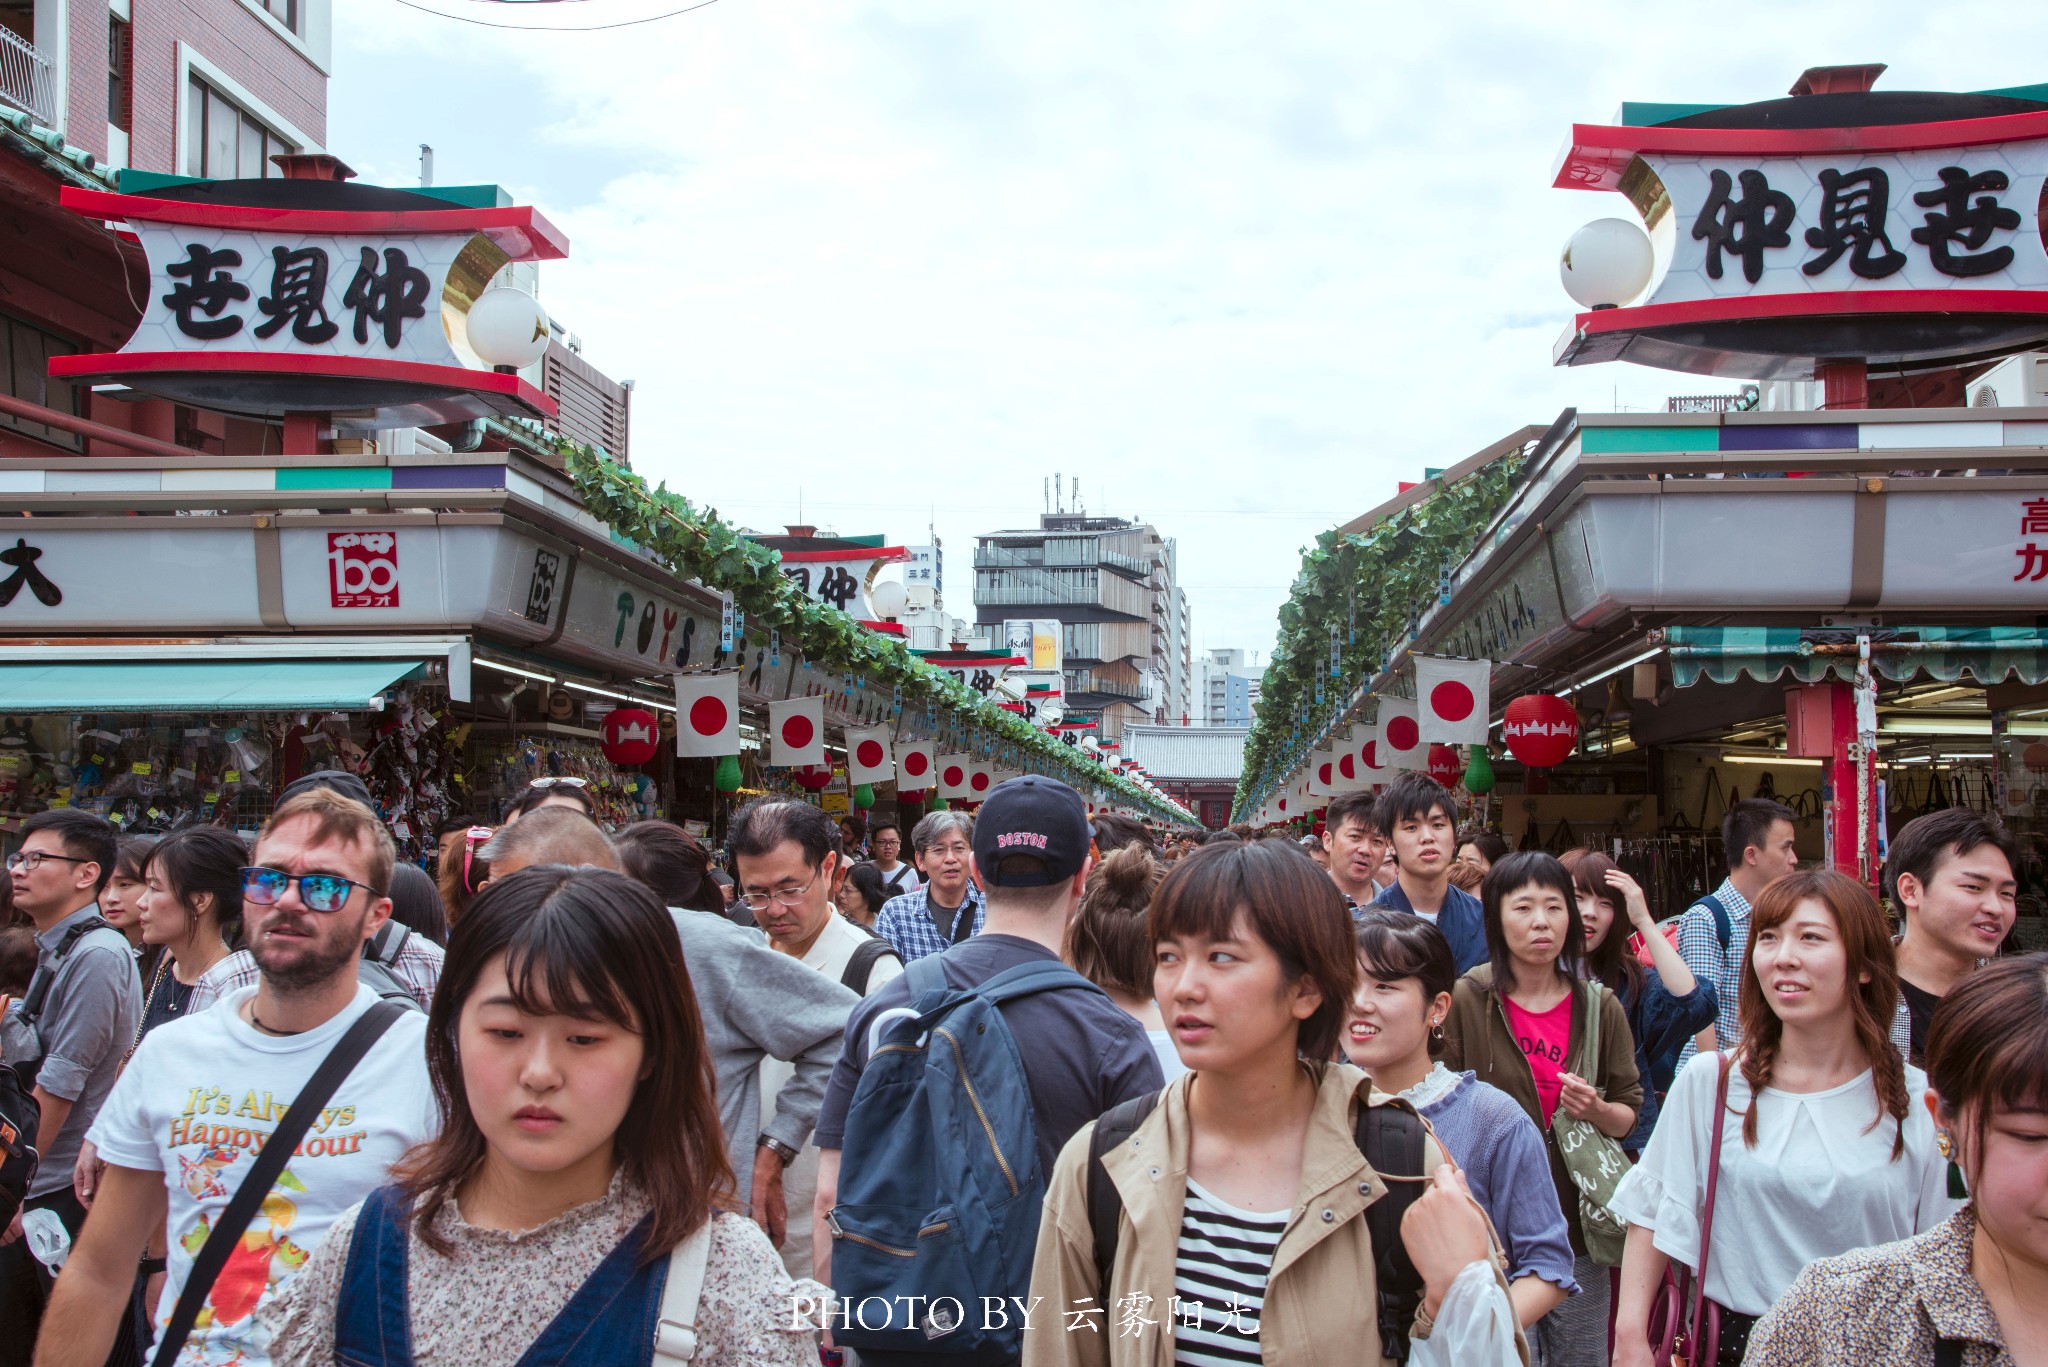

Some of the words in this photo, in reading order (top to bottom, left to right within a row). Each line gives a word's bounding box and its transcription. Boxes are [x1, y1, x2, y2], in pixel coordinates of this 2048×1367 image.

[1692, 166, 2022, 283] 仲見世
[908, 568, 930, 579] 三定
[337, 595, 392, 607] テラオ
[614, 592, 697, 668] TOYS
[724, 602, 732, 640] 仲見世
[1007, 638, 1031, 649] Asahi
[997, 832, 1048, 849] BOSTON
[183, 1086, 231, 1115] It's
[292, 1130, 367, 1157] our
